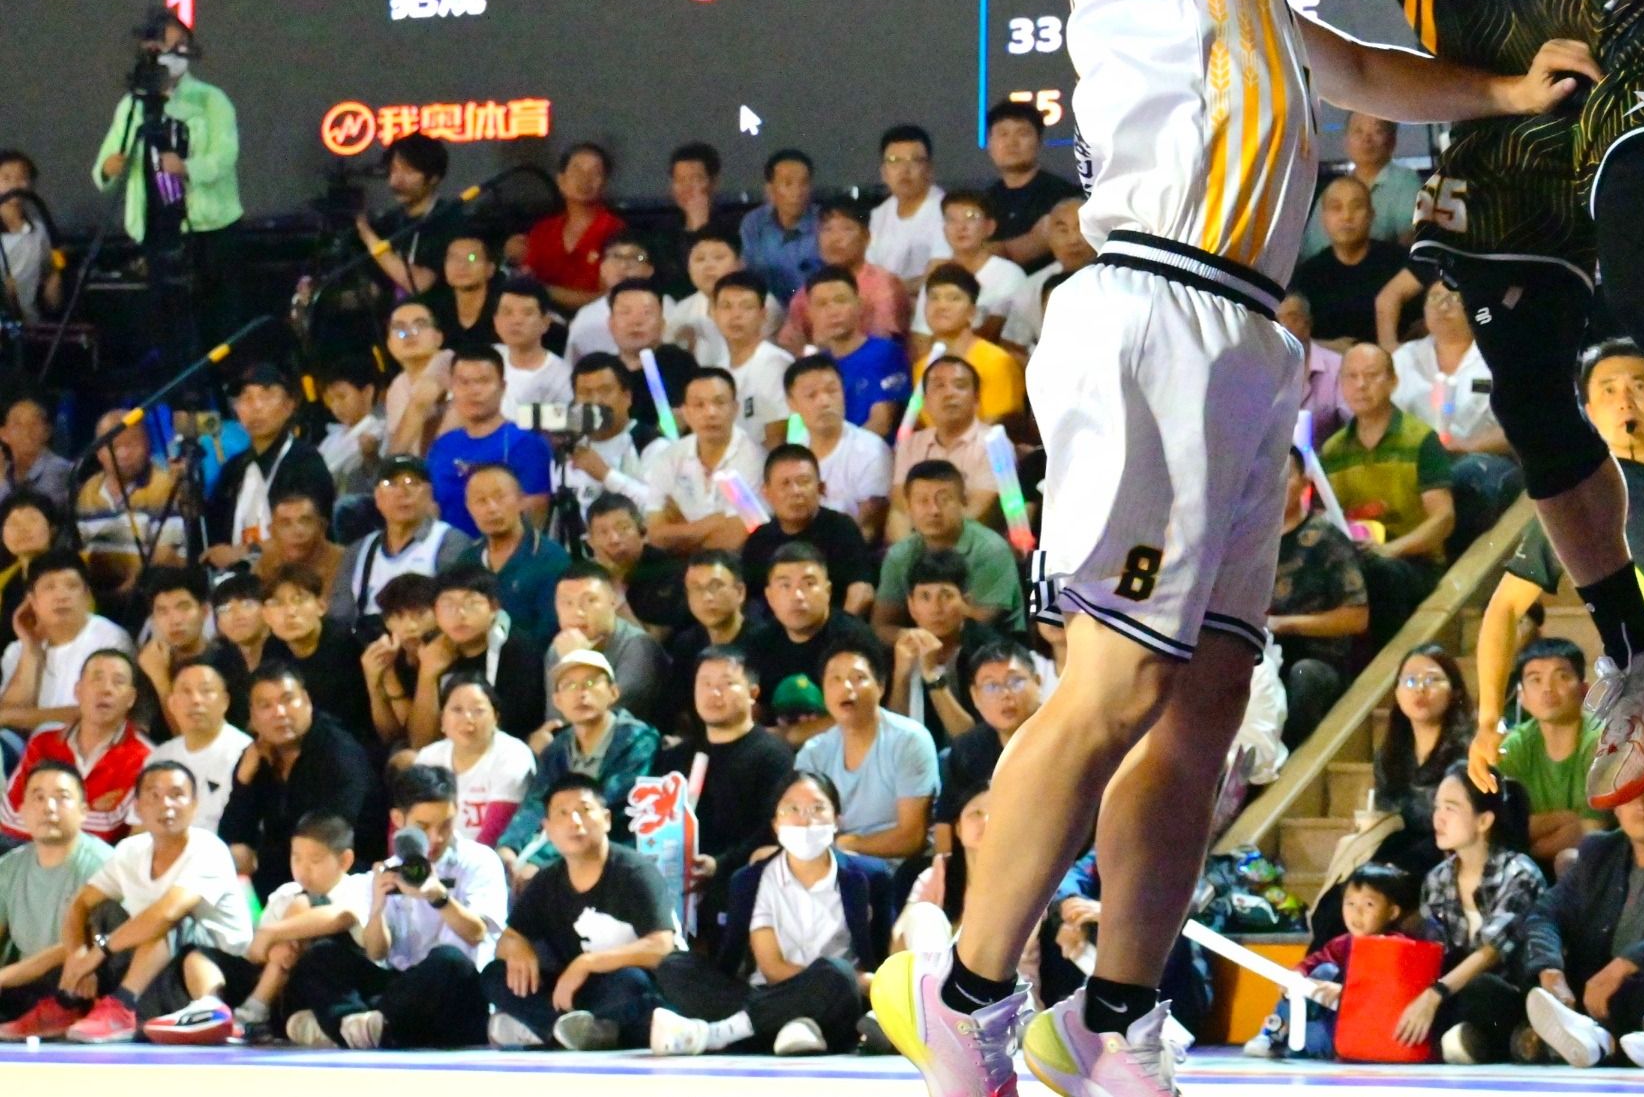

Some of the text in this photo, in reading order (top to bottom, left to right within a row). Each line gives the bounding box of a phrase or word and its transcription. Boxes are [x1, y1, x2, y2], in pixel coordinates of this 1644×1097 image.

[1006, 15, 1063, 55] 33
[378, 98, 550, 146] 我奥体育
[1009, 90, 1062, 126] 5
[1114, 545, 1164, 601] 8
